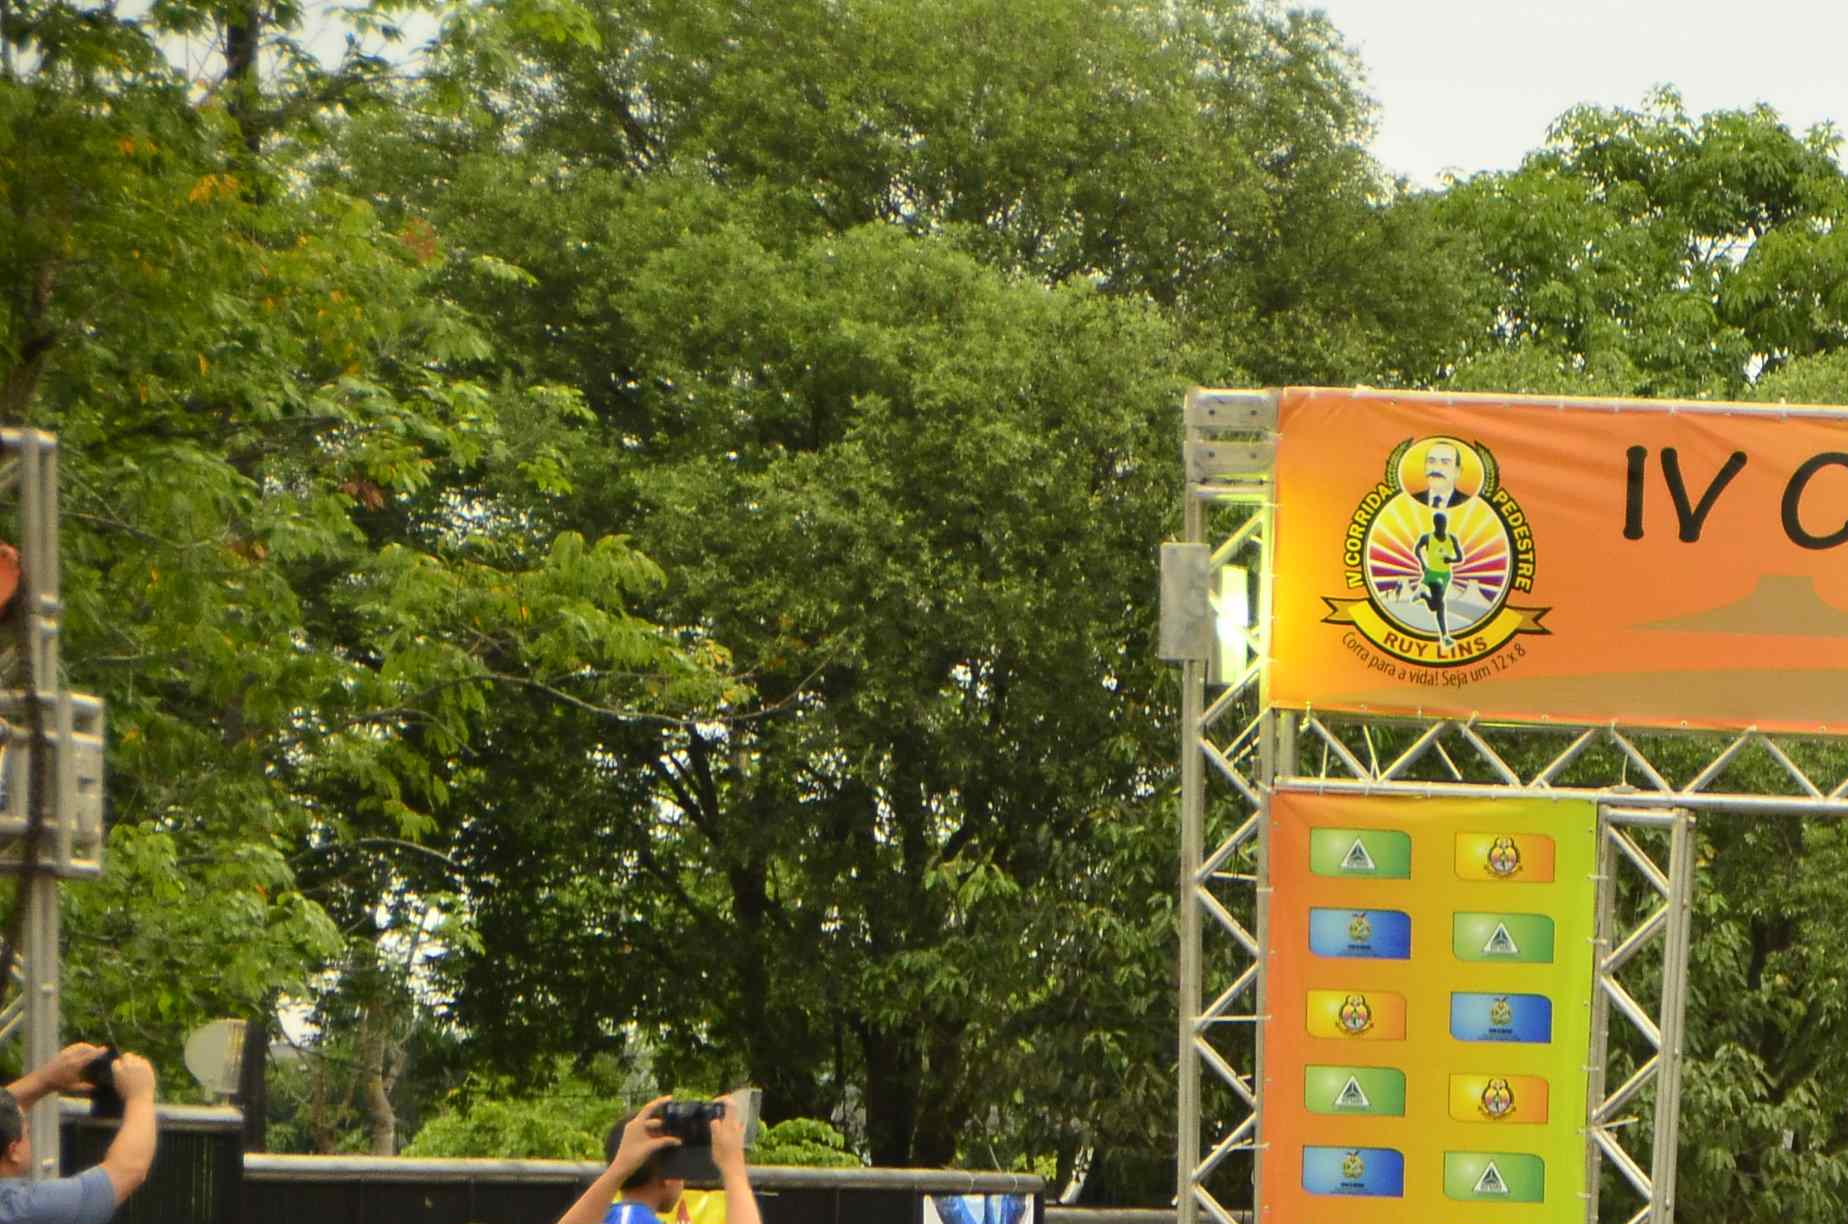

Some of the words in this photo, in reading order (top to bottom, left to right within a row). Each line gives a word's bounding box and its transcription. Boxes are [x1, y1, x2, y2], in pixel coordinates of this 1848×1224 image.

[1622, 446, 1747, 544] IV
[1344, 483, 1393, 567] CORRIDA
[1493, 489, 1534, 593] PEDESTRE
[1342, 631, 1370, 661] Corra
[1367, 656, 1396, 677] para
[1397, 669, 1406, 681] a
[1409, 669, 1440, 687] vida!
[1442, 671, 1468, 688] Seja
[1470, 666, 1491, 682] um
[1383, 632, 1430, 657] RUY
[1436, 636, 1488, 660] LINS
